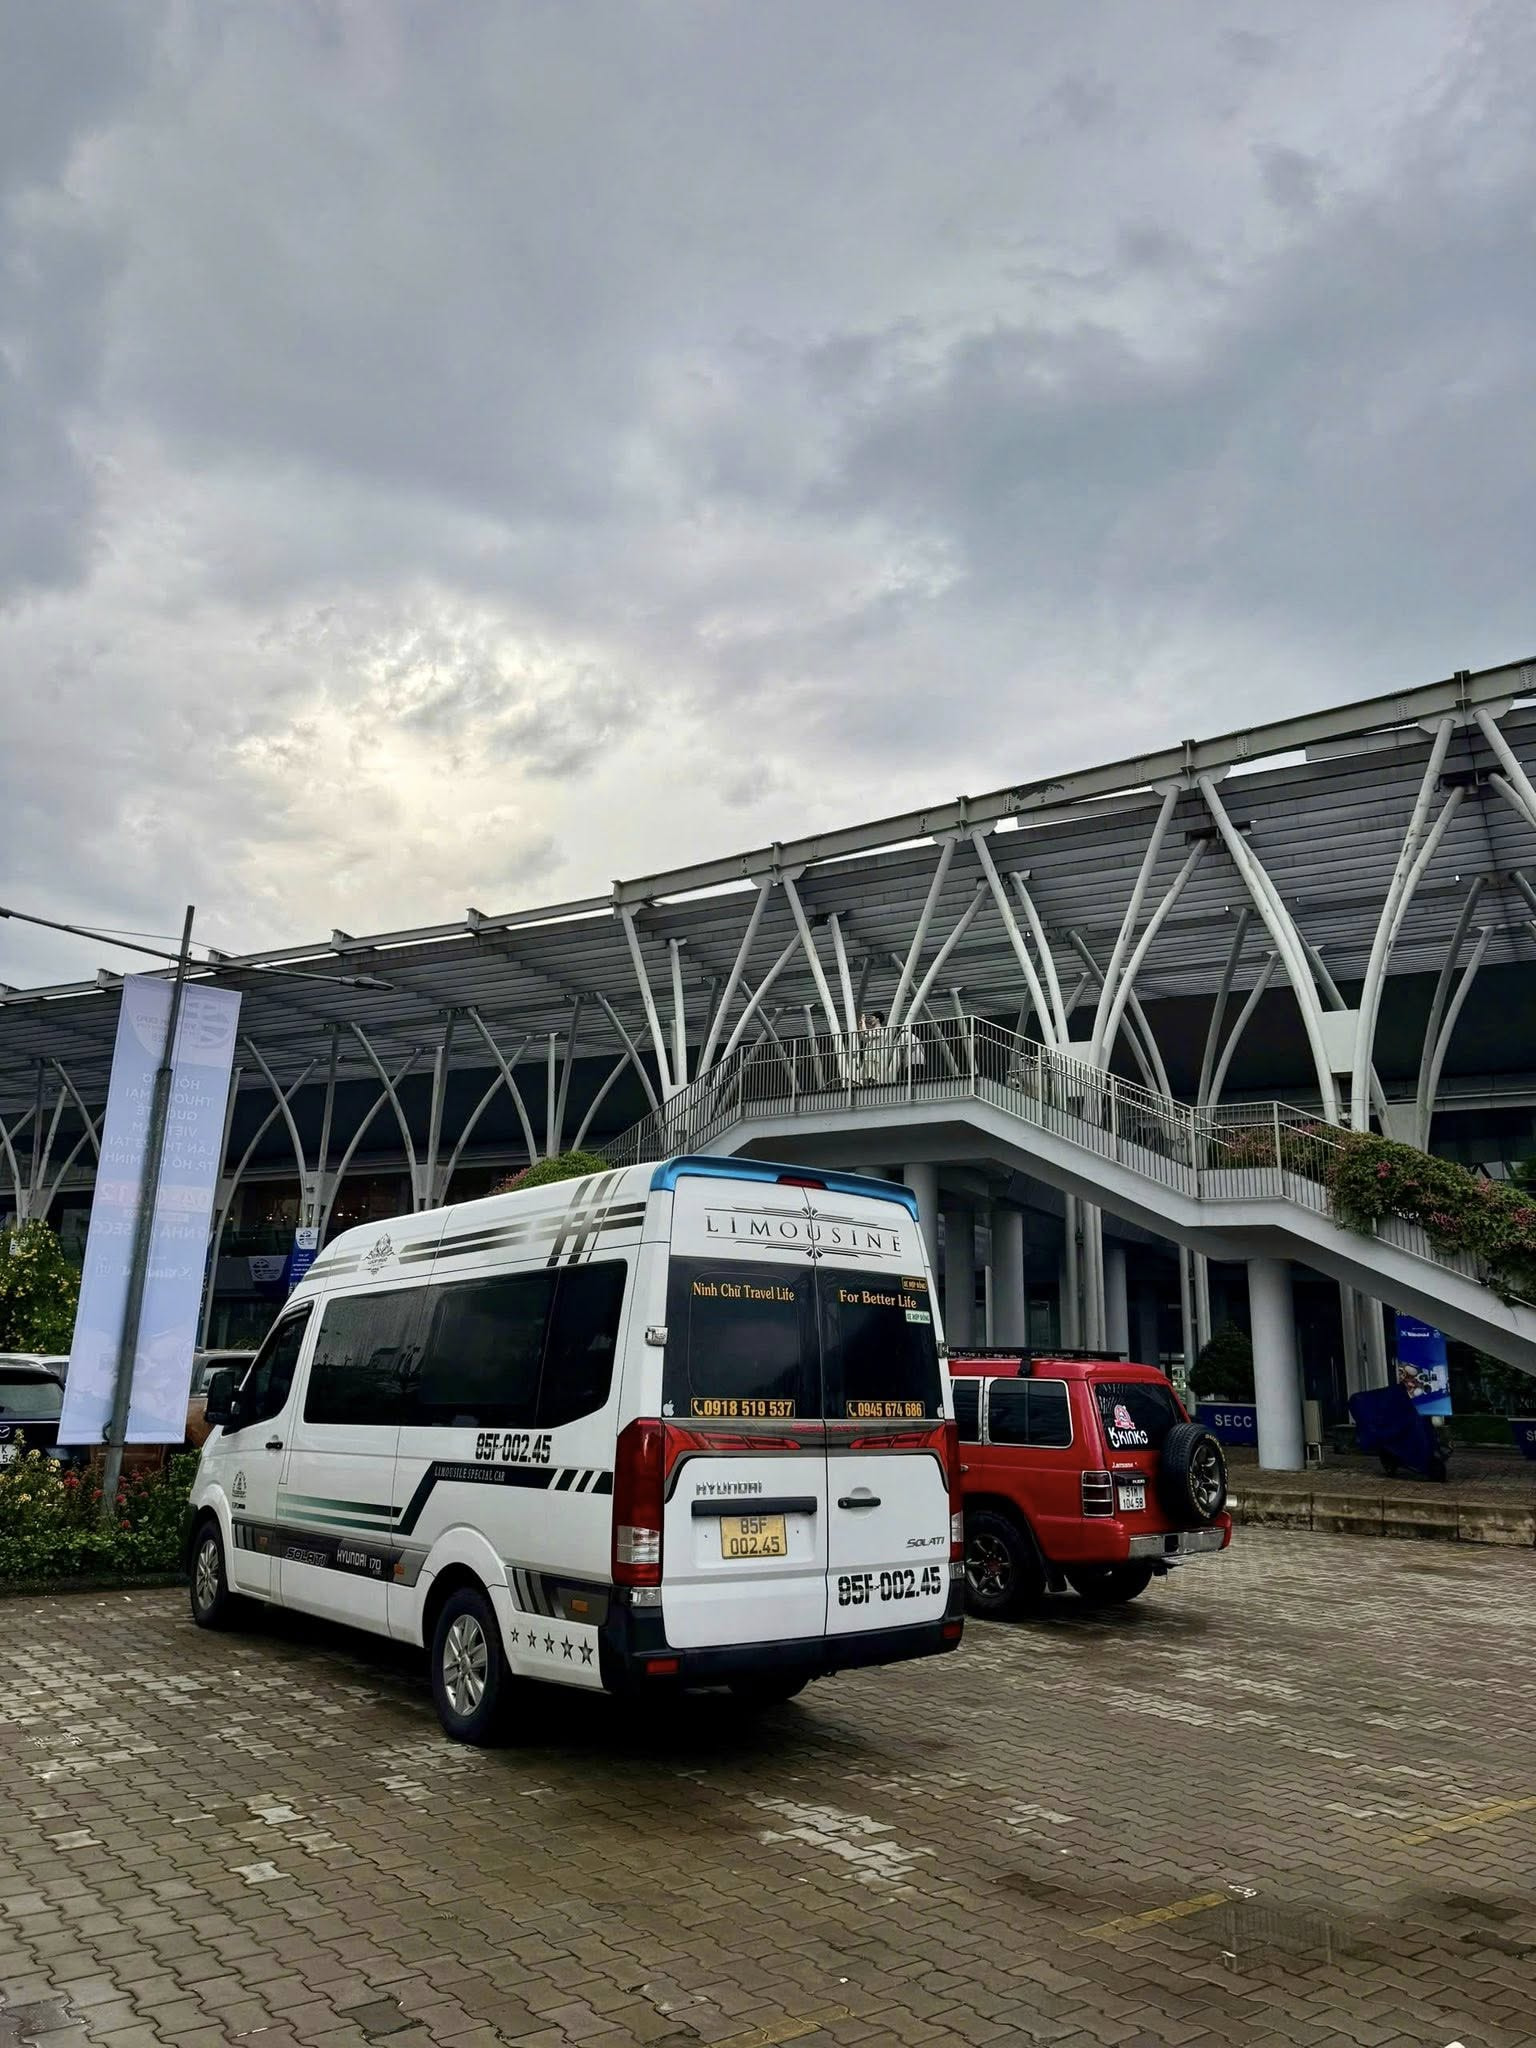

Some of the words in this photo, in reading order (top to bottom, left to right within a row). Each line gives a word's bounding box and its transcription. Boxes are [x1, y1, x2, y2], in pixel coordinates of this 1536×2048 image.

[706, 1215, 902, 1252] LIMOUSINE
[693, 1282, 718, 1297] Ninh
[743, 1285, 774, 1300] Travel
[776, 1287, 795, 1301] Life
[839, 1289, 859, 1303] For
[862, 1292, 896, 1307] Better
[898, 1294, 918, 1309] Life
[703, 1400, 738, 1417] 0918
[741, 1400, 766, 1417] 519
[769, 1401, 793, 1417] 537
[857, 1402, 883, 1418] 0945
[885, 1402, 904, 1418] 674
[905, 1403, 923, 1418] 686
[1214, 1414, 1253, 1428] SECC
[475, 1433, 553, 1464] 85F-002.45
[695, 1481, 763, 1496] HYUNDAI
[739, 1517, 768, 1535] 85F
[729, 1536, 780, 1556] 002.45
[905, 1536, 946, 1549] SOLATI
[284, 1546, 327, 1567] SOLATI
[336, 1549, 367, 1567] HYUNDAI
[837, 1566, 942, 1606] 85F-002.45
